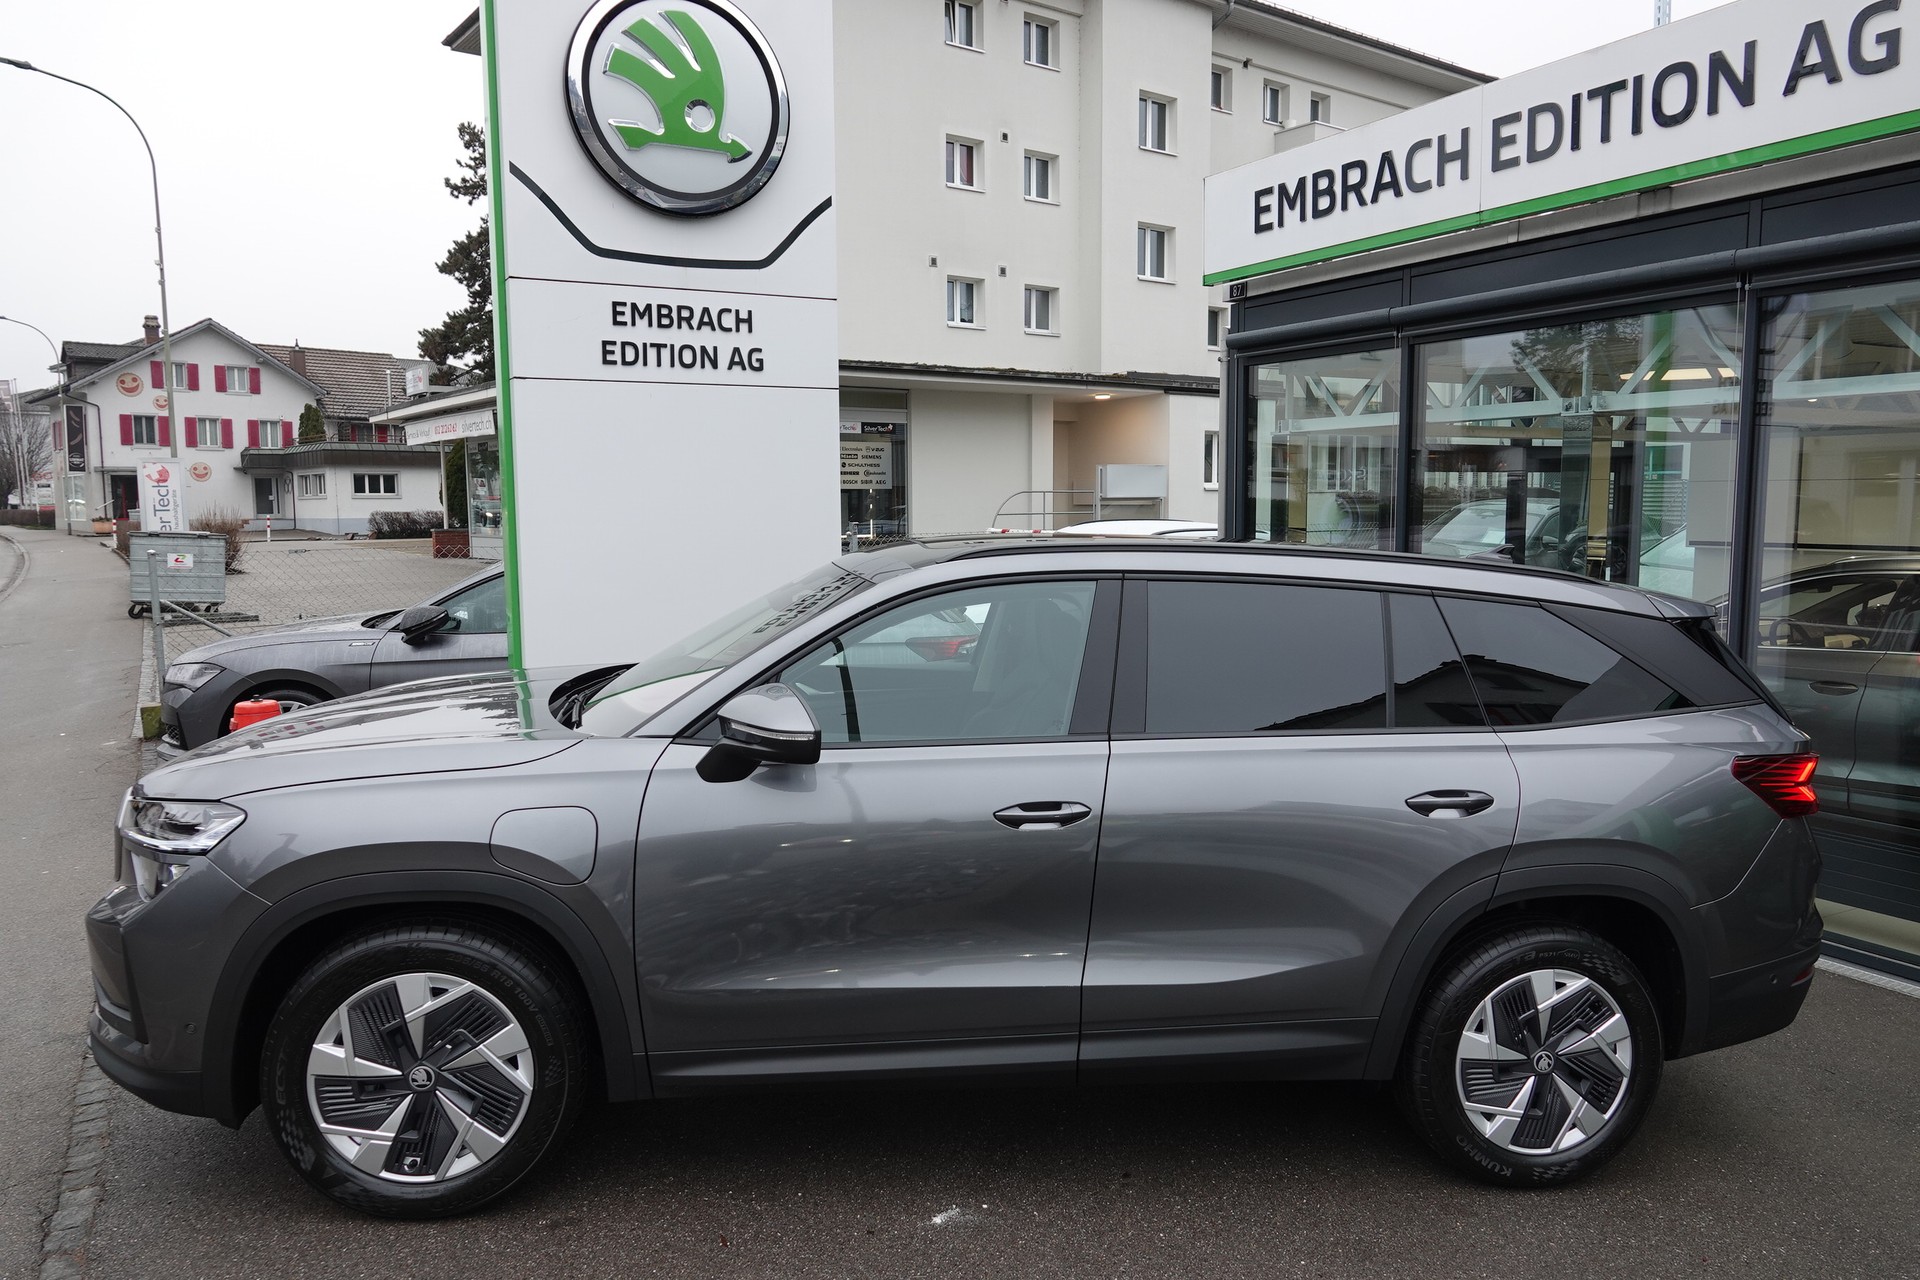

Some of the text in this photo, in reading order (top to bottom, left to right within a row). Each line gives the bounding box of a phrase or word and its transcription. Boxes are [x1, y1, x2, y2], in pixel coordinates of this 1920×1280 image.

[1254, 0, 1902, 234] EMBRACH EDITION AG
[1232, 284, 1242, 297] 87
[611, 300, 753, 334] EMBRACH
[601, 339, 764, 372] EDITION AG
[1456, 1134, 1513, 1177] KUMHO
